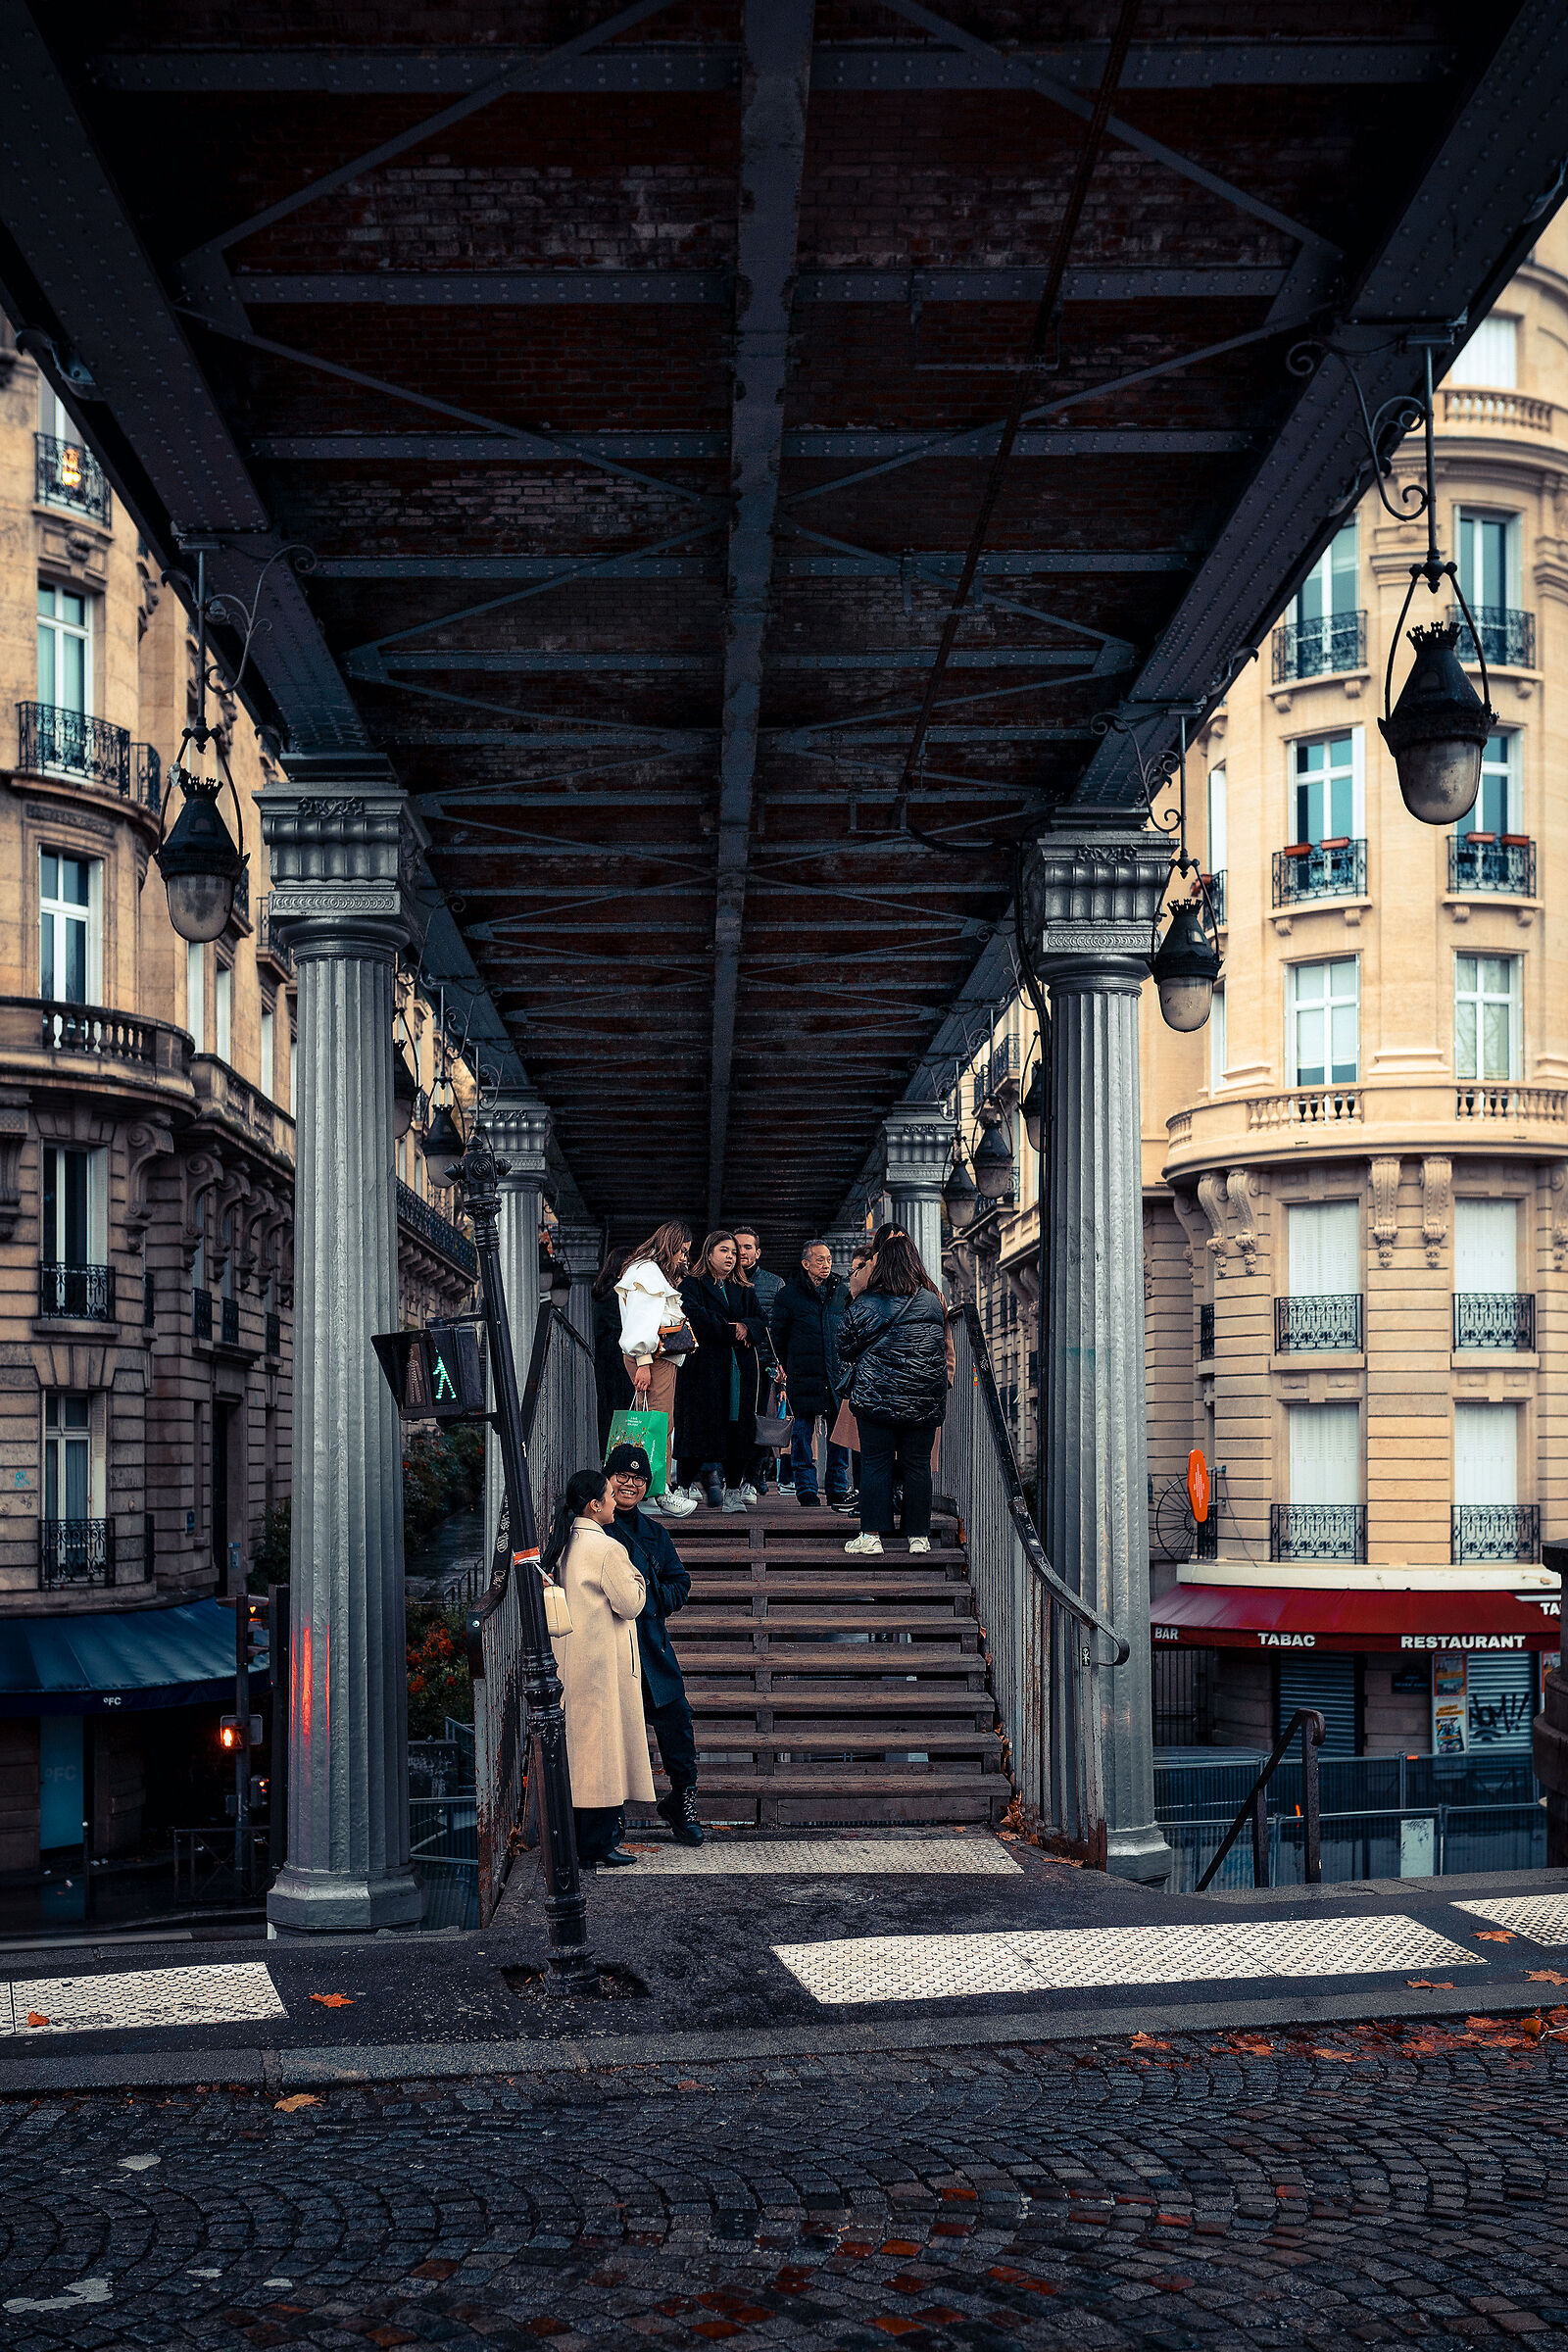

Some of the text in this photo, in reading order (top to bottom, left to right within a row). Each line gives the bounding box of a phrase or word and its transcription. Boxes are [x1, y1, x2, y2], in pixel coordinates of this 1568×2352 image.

[1540, 1602, 1562, 1616] TA
[1154, 1627, 1179, 1640] BAR
[1257, 1633, 1316, 1647] TABAC
[1400, 1635, 1526, 1648] RESTAURANT
